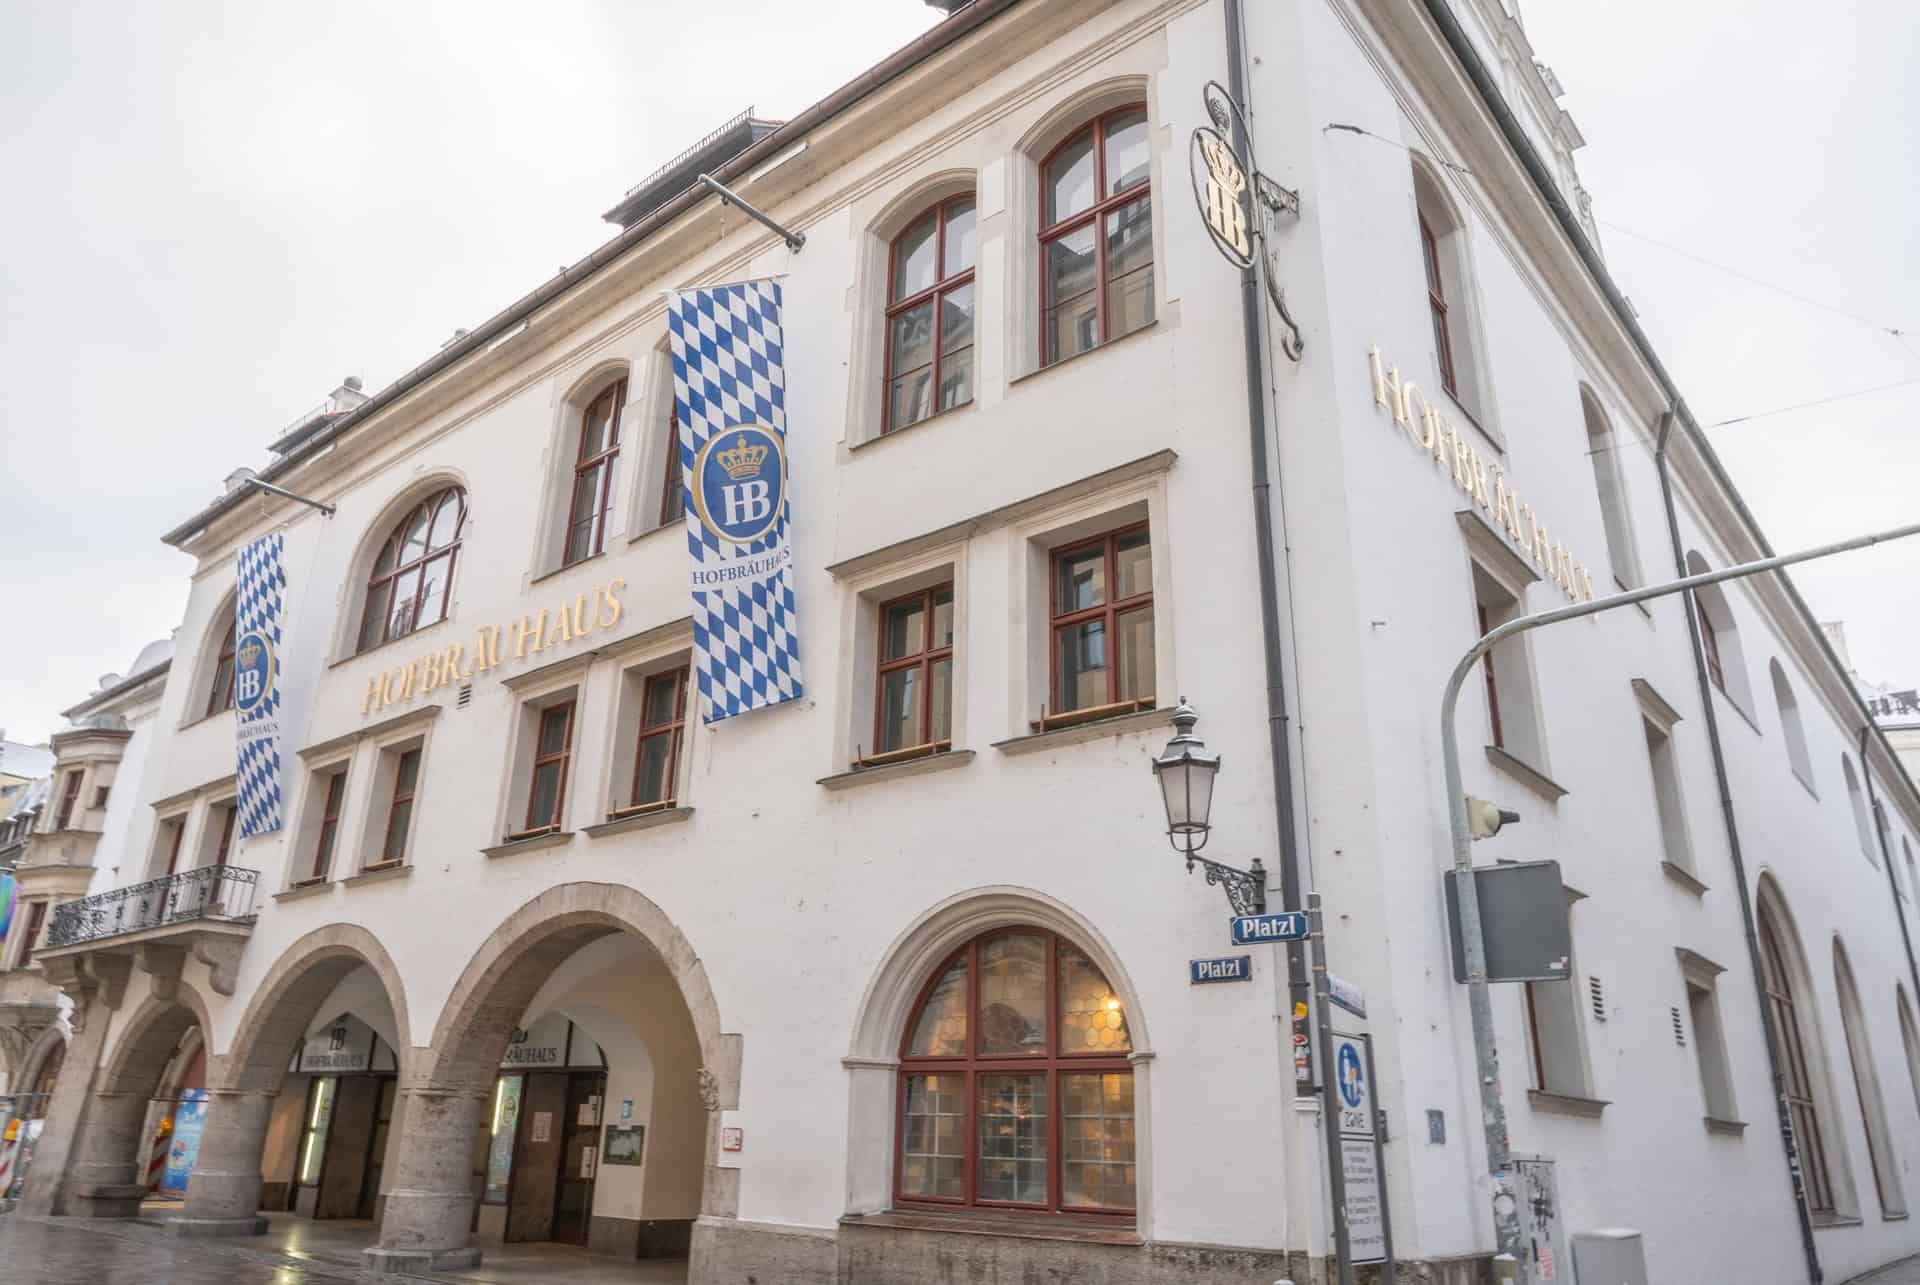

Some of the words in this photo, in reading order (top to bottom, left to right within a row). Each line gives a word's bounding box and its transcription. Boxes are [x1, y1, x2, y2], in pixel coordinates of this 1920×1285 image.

[721, 480, 771, 526] HB
[692, 545, 790, 585] HOFBRÄUHAUS
[361, 576, 626, 715] HOFBRÄUHAUS
[239, 669, 260, 701] HB
[1242, 916, 1296, 939] Platzl
[1198, 959, 1241, 979] Platzl
